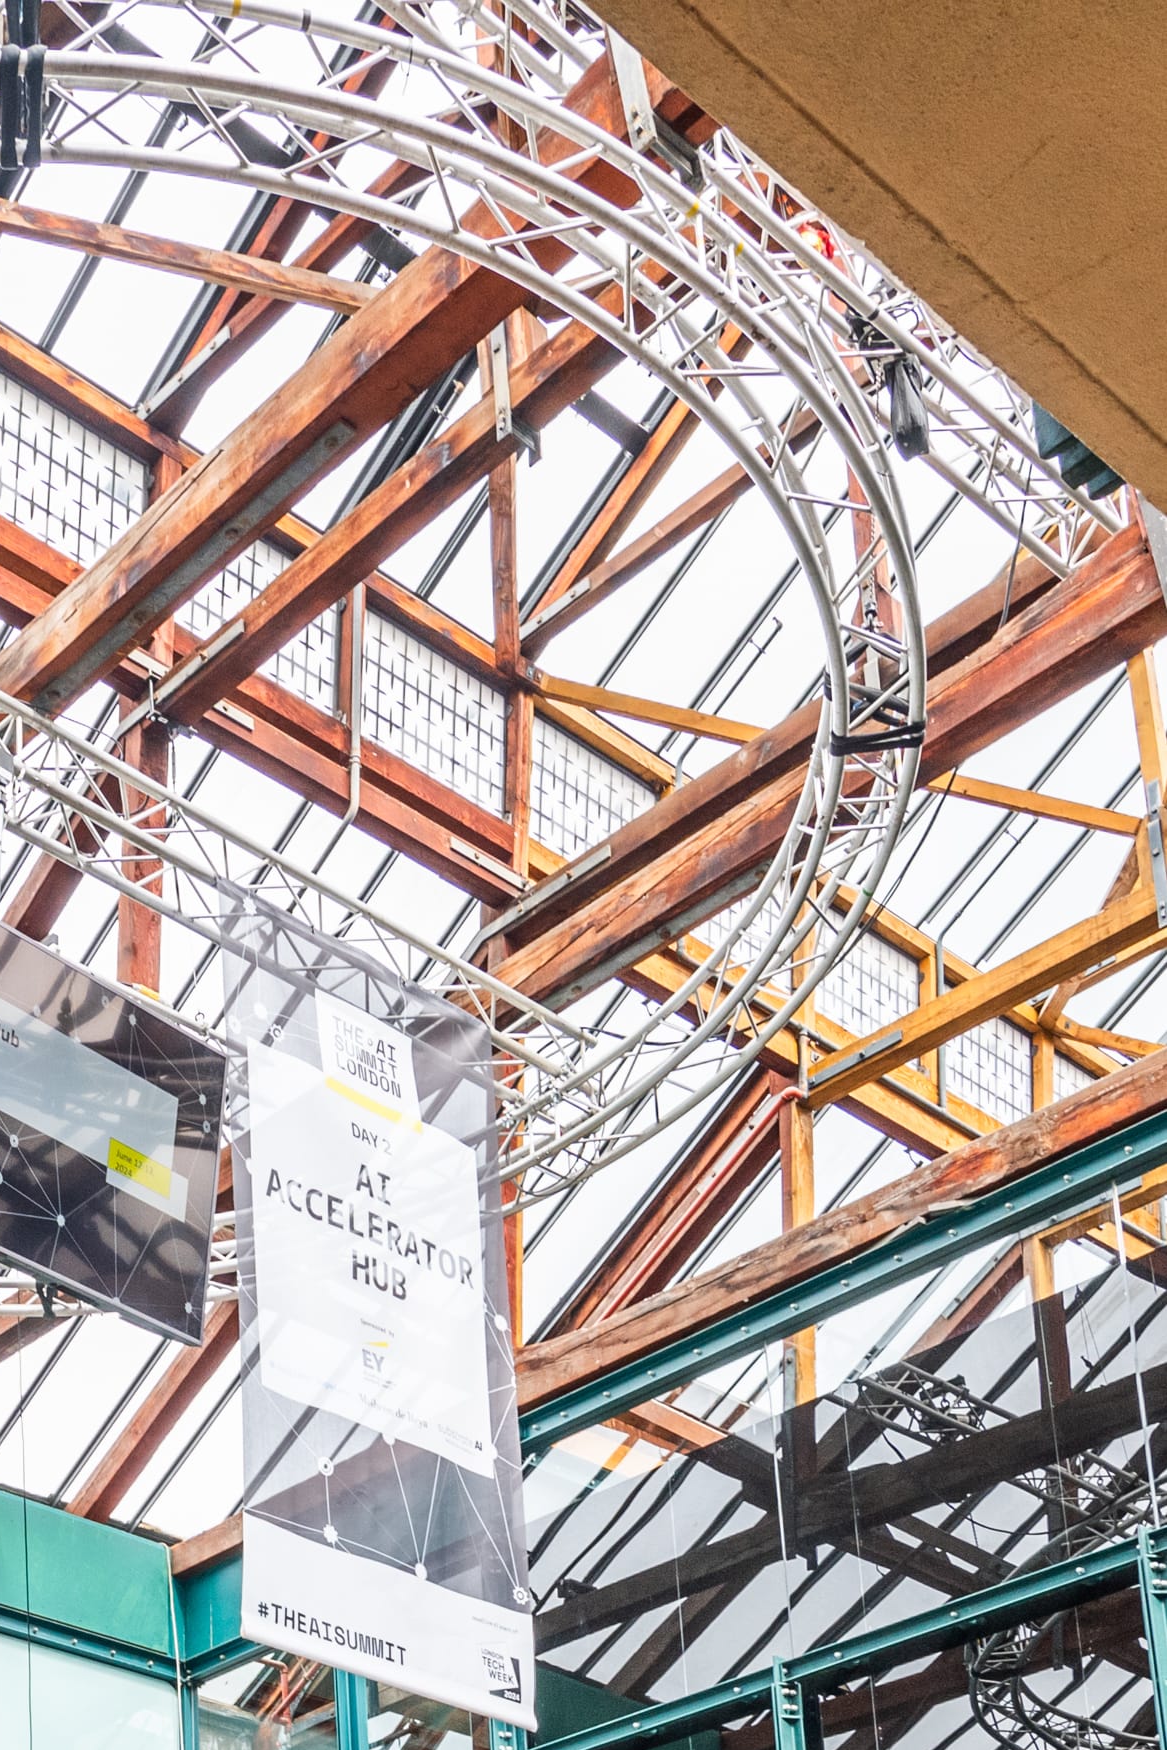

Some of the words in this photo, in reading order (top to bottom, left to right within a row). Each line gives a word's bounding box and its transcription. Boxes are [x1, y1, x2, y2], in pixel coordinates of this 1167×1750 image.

[332, 1015, 364, 1047] THE
[376, 1039, 397, 1064] AI
[334, 1033, 398, 1080] SUMMIT
[336, 1051, 402, 1099] LONDON
[351, 1121, 379, 1149] DAY
[381, 1138, 393, 1156] 2
[114, 1161, 133, 1177] 2024
[355, 1163, 391, 1206] AI
[265, 1167, 475, 1291] ACCELERATOR
[351, 1248, 407, 1301] HUB
[361, 1348, 385, 1373] EY
[257, 1601, 407, 1666] #THEAISUMMIT
[481, 1655, 506, 1672] TECH
[488, 1668, 515, 1686] WEEK
